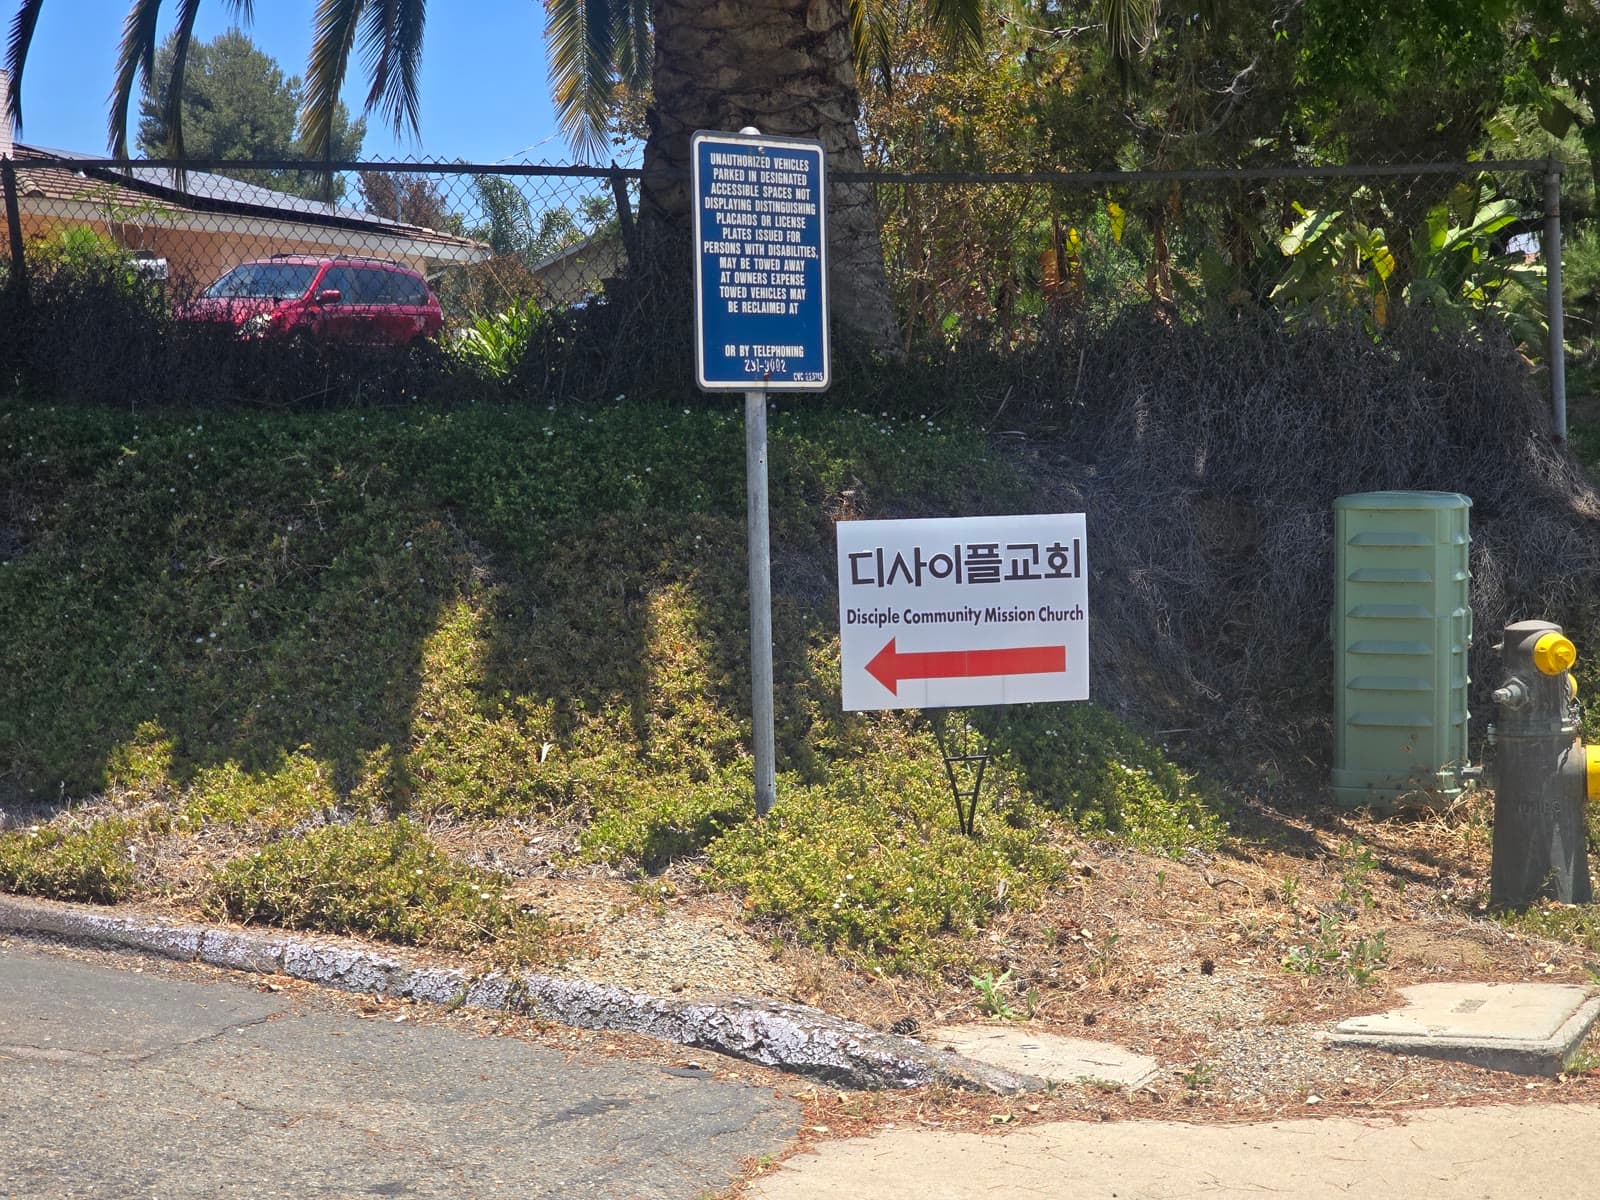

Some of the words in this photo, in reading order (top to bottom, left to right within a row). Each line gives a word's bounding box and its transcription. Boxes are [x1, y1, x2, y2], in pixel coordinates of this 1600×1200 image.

[710, 152, 771, 169] UNAUTHORIZED
[774, 157, 809, 172] VEHICLES
[713, 168, 745, 182] PARKED
[749, 170, 757, 183] IN
[760, 171, 807, 186] DESIGNATED
[711, 182, 759, 197] ACCESSIBLE
[762, 186, 792, 199] SPACES
[795, 188, 811, 201] NOT
[704, 197, 752, 211] DISPLAYING
[755, 200, 816, 215] DISTINGUISHING
[716, 212, 758, 226] PLACARDS
[761, 215, 772, 227] OR
[775, 216, 806, 229] LICENSE
[722, 227, 752, 240] PLATES
[755, 229, 783, 242] ISSUED
[786, 230, 801, 243] FOR
[704, 241, 741, 255] PERSONS
[744, 243, 765, 256] WITH
[719, 257, 736, 269] MAY
[740, 258, 751, 270] BE
[754, 258, 780, 271] TOWED
[783, 260, 805, 272] AWAY
[720, 271, 731, 283] AT
[734, 272, 768, 285] OWNERS
[771, 273, 805, 286] EXPENSE
[719, 286, 747, 299] TOWED
[750, 287, 787, 300] VEHICLES
[790, 288, 806, 301] MAY
[728, 301, 738, 313] BE
[741, 301, 785, 314] RECLAIMED
[789, 302, 799, 314] AT
[725, 344, 736, 357] OR
[739, 344, 749, 357] BY
[752, 345, 804, 358] TELEPHONING
[848, 538, 1081, 588] 디사이플교회
[847, 606, 900, 629] Disciple
[903, 605, 982, 626] Community
[984, 606, 1035, 623] Mission
[1038, 604, 1084, 622] Church
